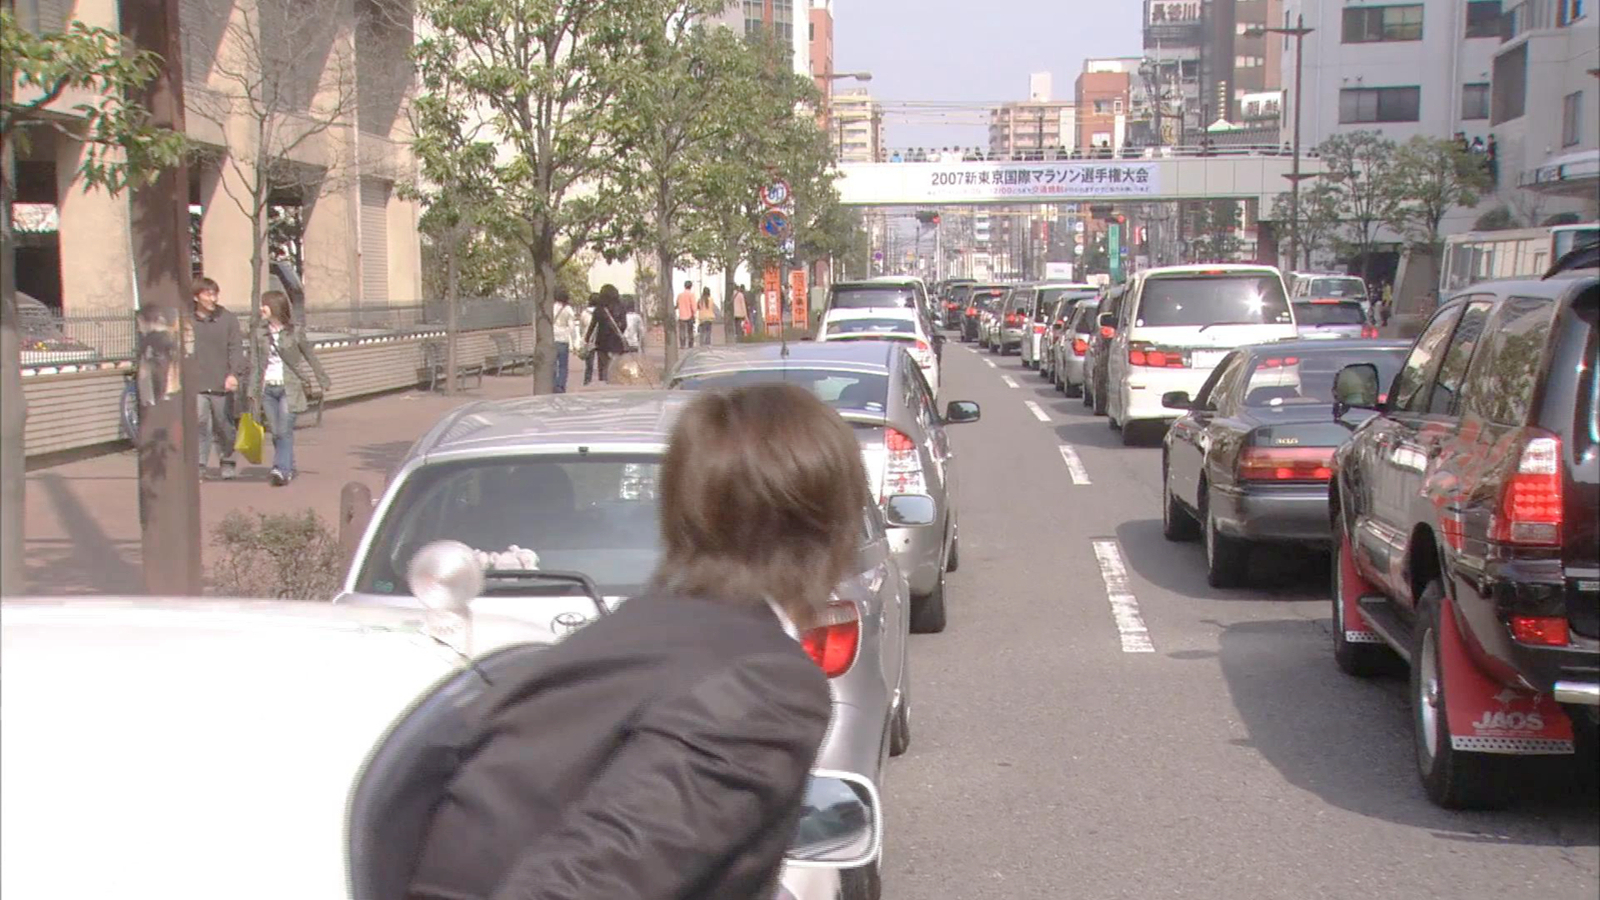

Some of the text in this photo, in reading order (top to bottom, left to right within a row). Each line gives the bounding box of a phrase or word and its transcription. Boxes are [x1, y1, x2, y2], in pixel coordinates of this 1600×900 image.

[931, 167, 1149, 186] 2007新東京国際マラソン選手権大会
[1472, 711, 1544, 731] JAOS
